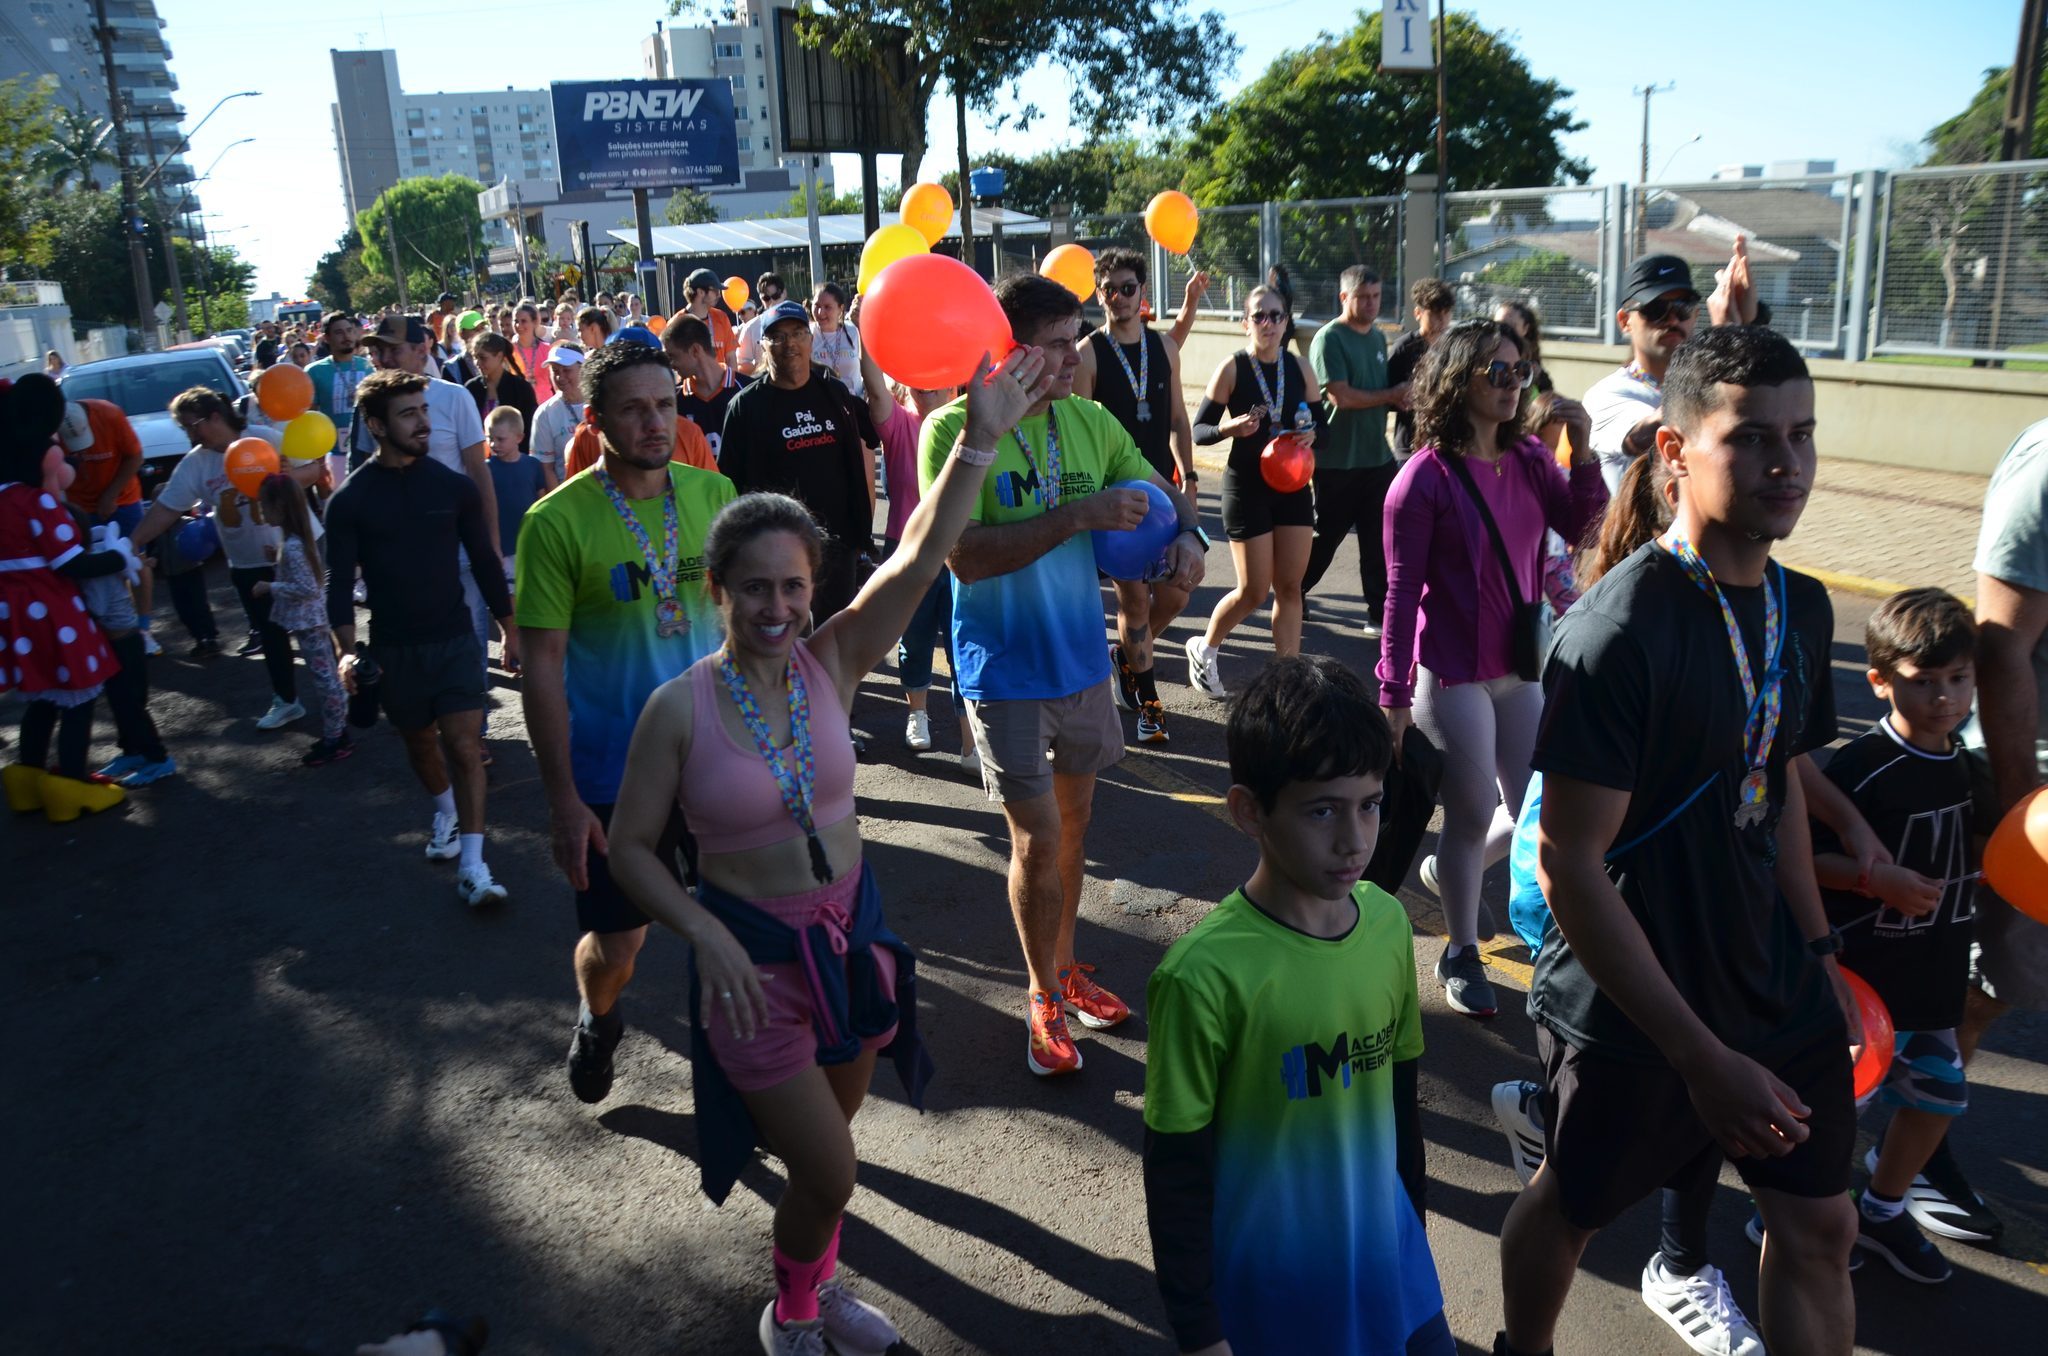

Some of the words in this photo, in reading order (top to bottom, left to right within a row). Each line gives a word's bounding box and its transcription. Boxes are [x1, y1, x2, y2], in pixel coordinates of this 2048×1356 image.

[583, 88, 704, 121] PBNEW
[614, 119, 707, 134] SISTEMAS
[607, 141, 641, 152] Soluções
[642, 139, 689, 150] tecnológicas
[621, 149, 653, 159] produtos
[795, 410, 815, 423] Pai,
[782, 422, 822, 438] Gaúcho
[825, 419, 836, 431] &
[786, 433, 836, 450] Colorado.
[1352, 1018, 1396, 1052] ACADE
